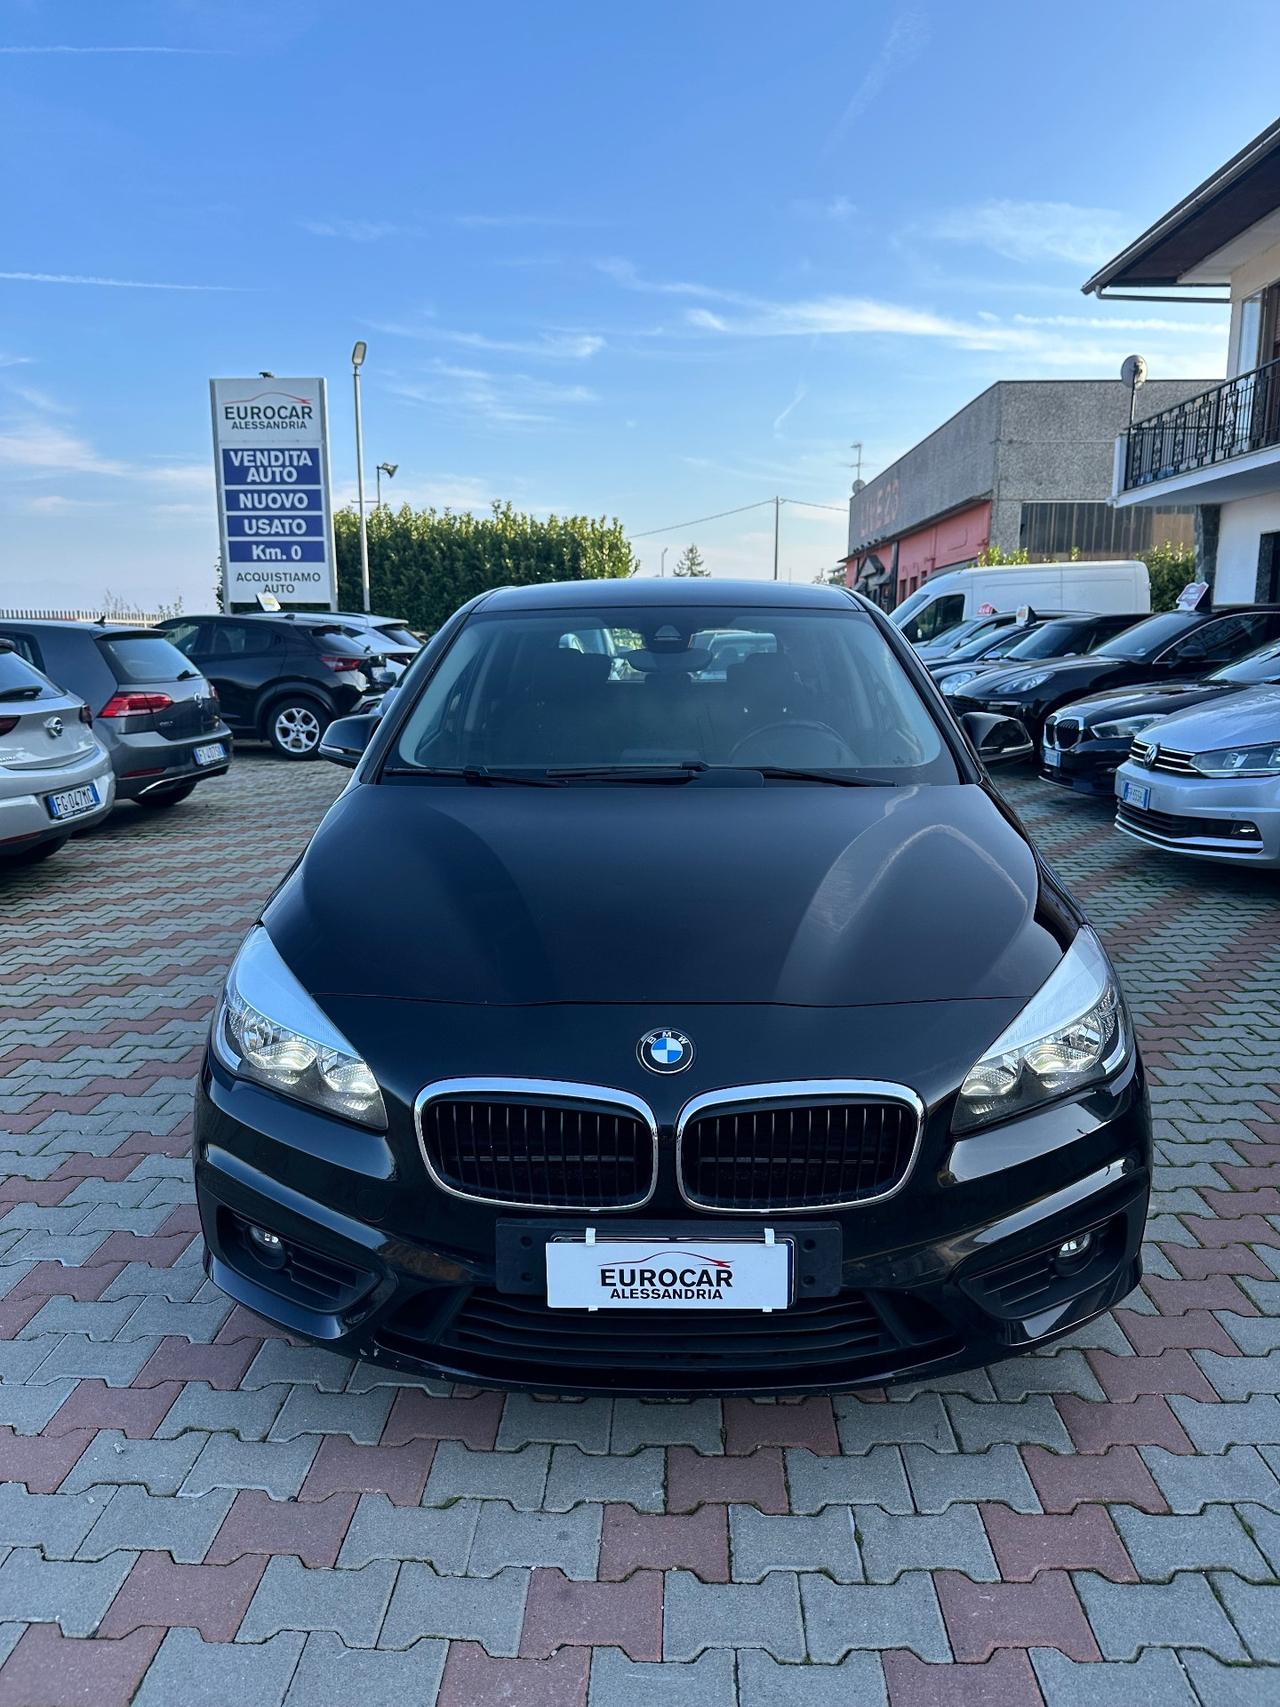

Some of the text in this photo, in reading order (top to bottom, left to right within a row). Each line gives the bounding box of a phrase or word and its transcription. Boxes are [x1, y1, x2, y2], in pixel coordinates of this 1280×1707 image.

[224, 405, 313, 420] EUROCAR
[231, 420, 307, 430] ALESSANDRIA
[229, 450, 313, 467] VENDITA
[246, 466, 298, 483] AUTO
[239, 492, 308, 509] NUOVO
[243, 519, 307, 534] USATO
[251, 544, 302, 560] Km. 0
[236, 572, 321, 583] ACQUISTIAMO
[263, 584, 295, 593] AUTO
[646, 1031, 689, 1044] BMW
[600, 1268, 733, 1288] EUROCAR
[610, 1288, 723, 1300] ALESSANDRIA
